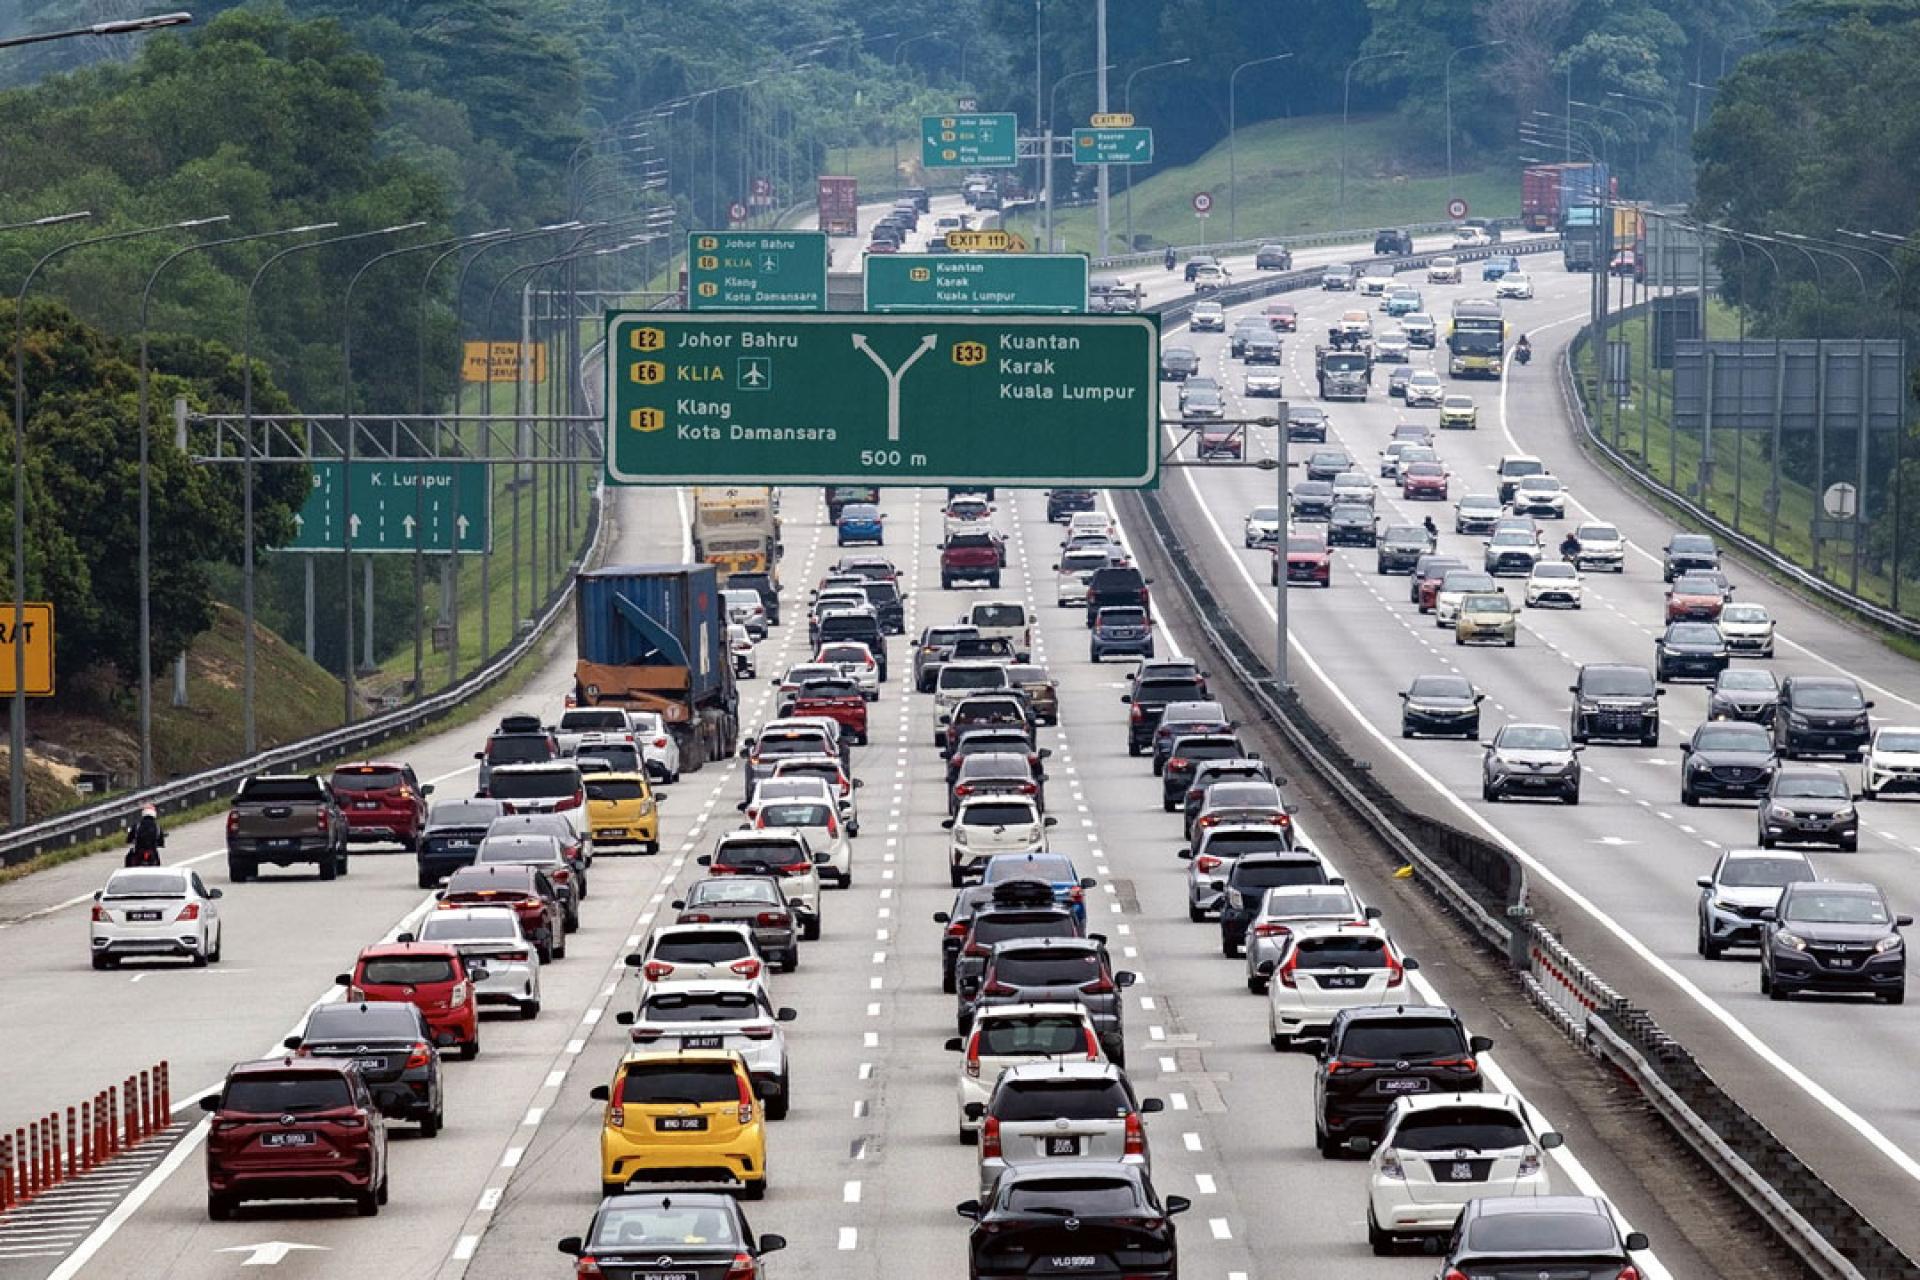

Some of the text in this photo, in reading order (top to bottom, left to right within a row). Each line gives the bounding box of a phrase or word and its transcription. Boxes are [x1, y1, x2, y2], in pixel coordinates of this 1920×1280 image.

[725, 239, 796, 250] Johor Bahru
[951, 235, 1004, 246] EXIT 111
[725, 257, 752, 268] KLIA
[936, 263, 984, 273] Kuantan
[725, 277, 757, 289] Klang
[936, 277, 968, 287] Karak
[725, 292, 817, 303] Kota Damansara
[936, 290, 1015, 304] Kuala Lumpur
[638, 333, 657, 347] E2
[678, 332, 798, 347] Johor Bahru
[1000, 334, 1080, 349] Kuantan
[955, 346, 983, 362] E33
[638, 366, 657, 381] E6
[678, 366, 724, 381] KLIA
[1000, 359, 1055, 374] Karak
[1000, 384, 1135, 402] Kuala Lumpur
[678, 400, 732, 418] Klang
[640, 412, 656, 427] E1
[678, 425, 837, 440] Kota Damansara
[861, 451, 927, 466] 500 m
[371, 473, 386, 486] K.
